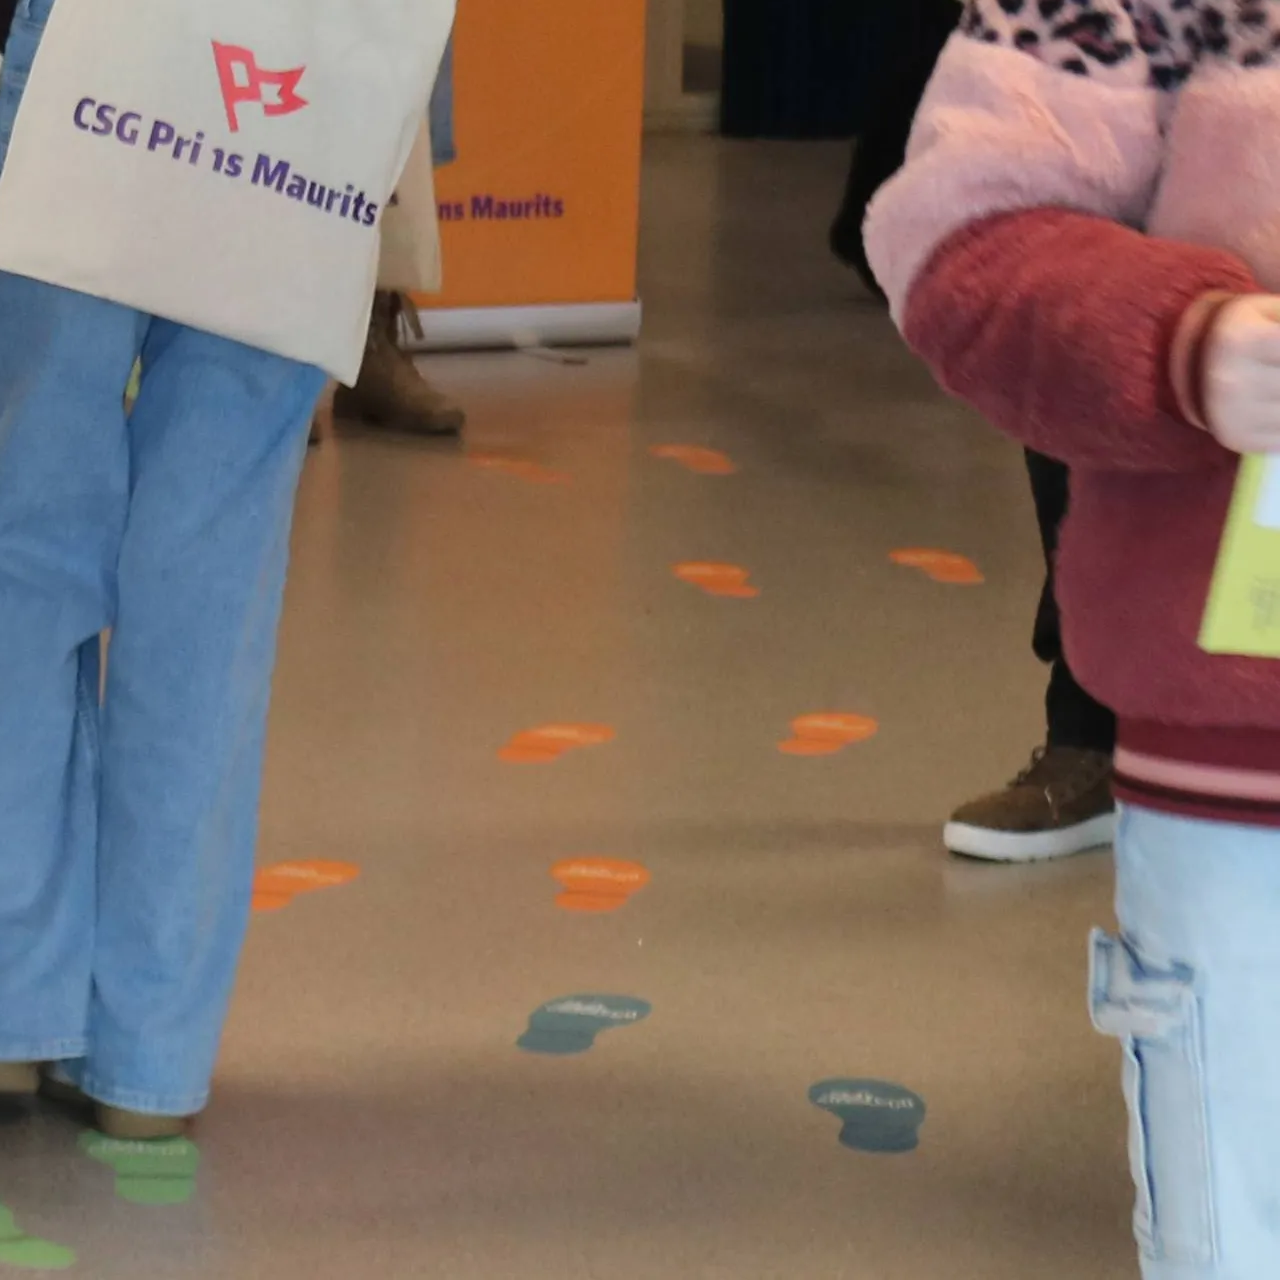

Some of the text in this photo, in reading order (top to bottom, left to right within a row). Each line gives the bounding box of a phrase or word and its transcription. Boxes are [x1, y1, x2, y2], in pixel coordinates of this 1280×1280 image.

[73, 96, 142, 146] CSG
[251, 153, 378, 227] Maurits
[471, 193, 565, 219] Maurits
